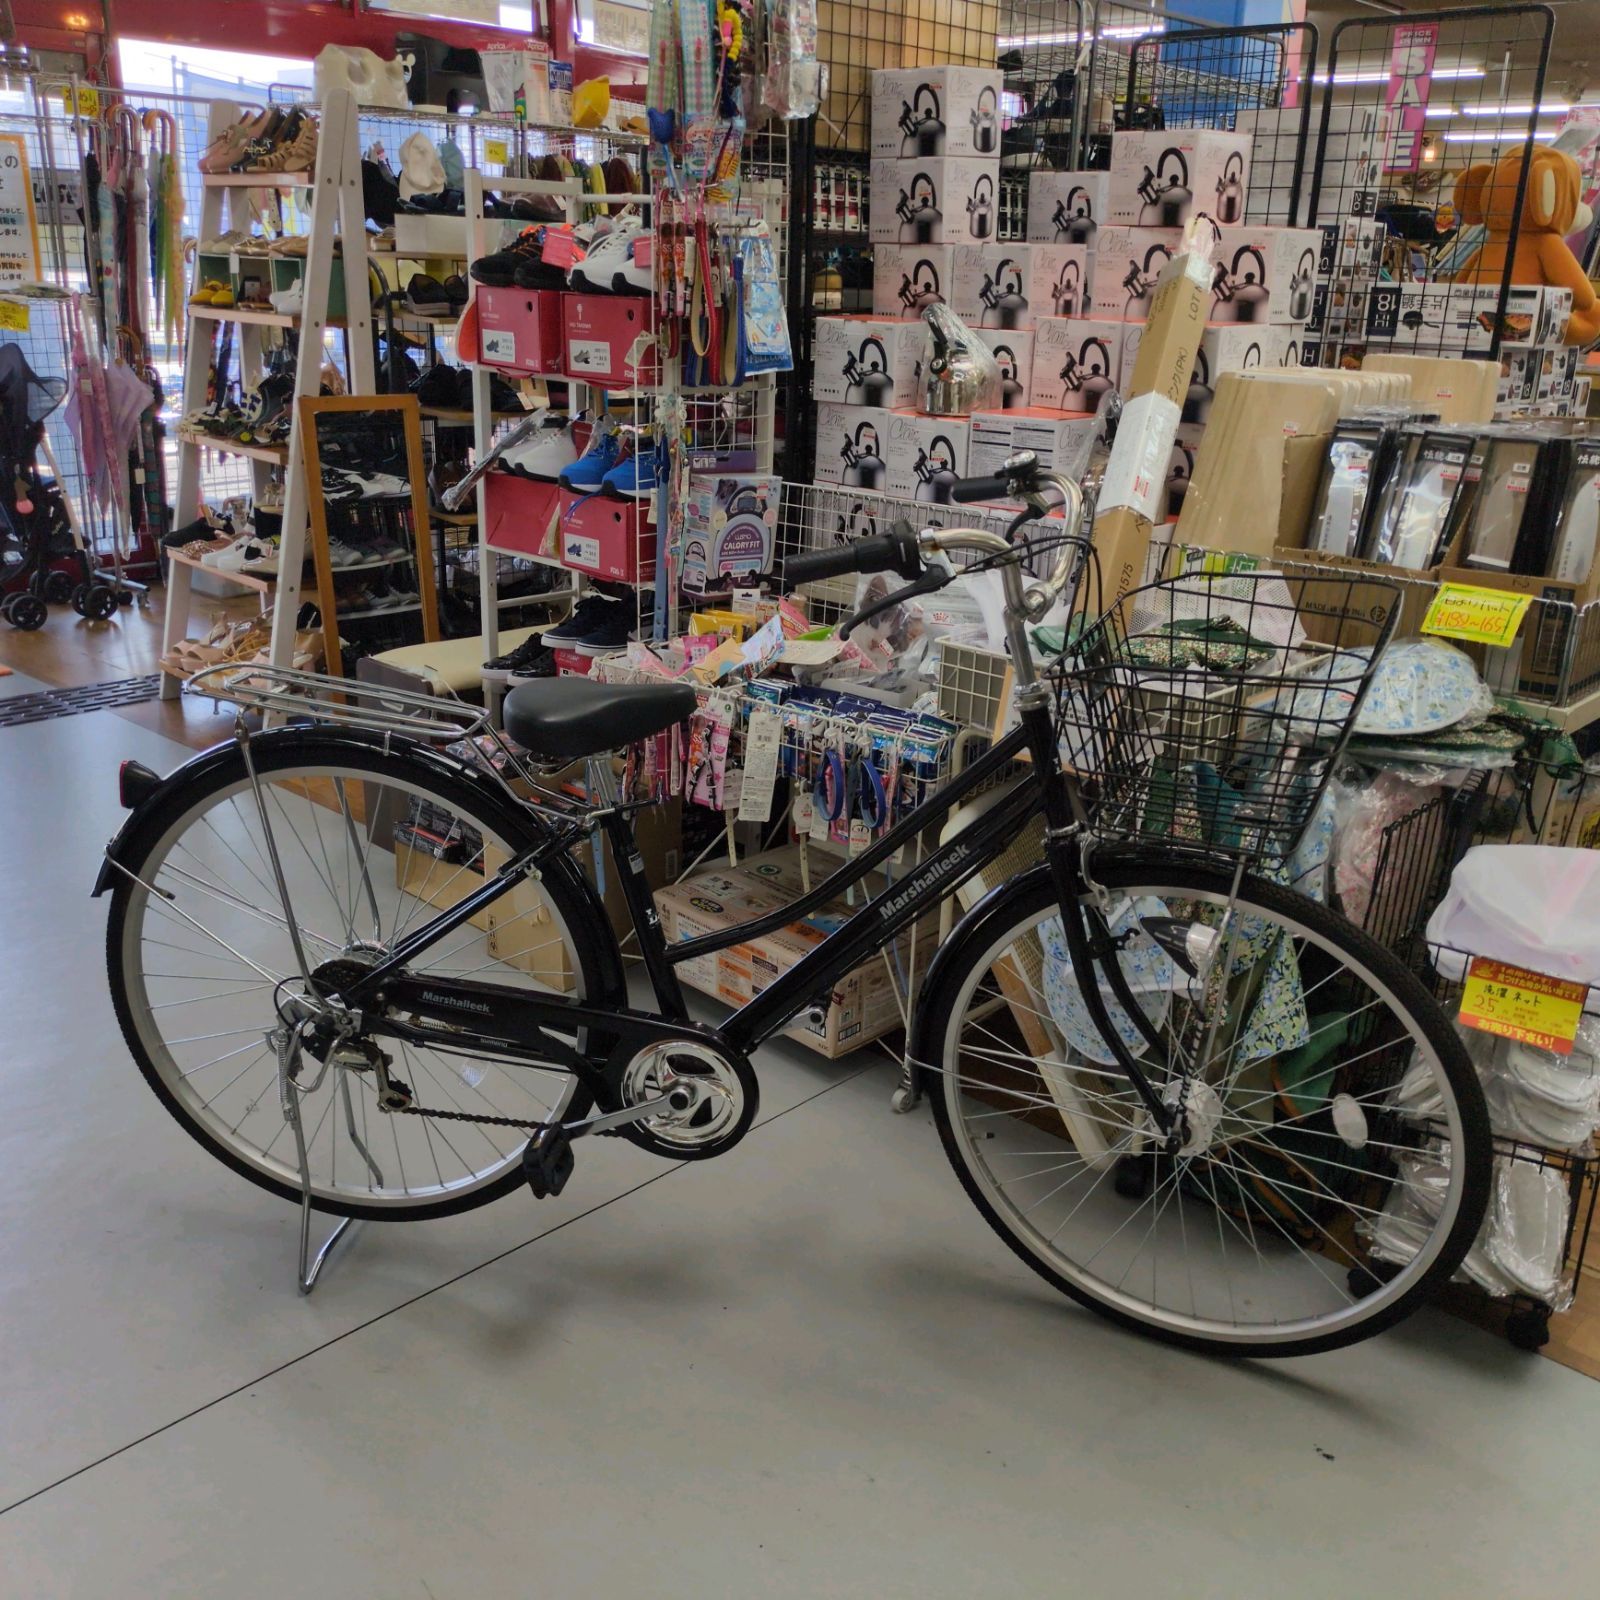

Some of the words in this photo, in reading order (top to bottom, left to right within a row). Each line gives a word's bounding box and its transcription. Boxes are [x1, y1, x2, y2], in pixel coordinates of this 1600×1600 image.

[1386, 46, 1427, 168] SALE
[1188, 292, 1203, 321] LOT
[723, 541, 750, 551] CALORY
[749, 540, 760, 549] FIT
[880, 844, 971, 920] Marshalleek
[1472, 993, 1499, 1013] 25
